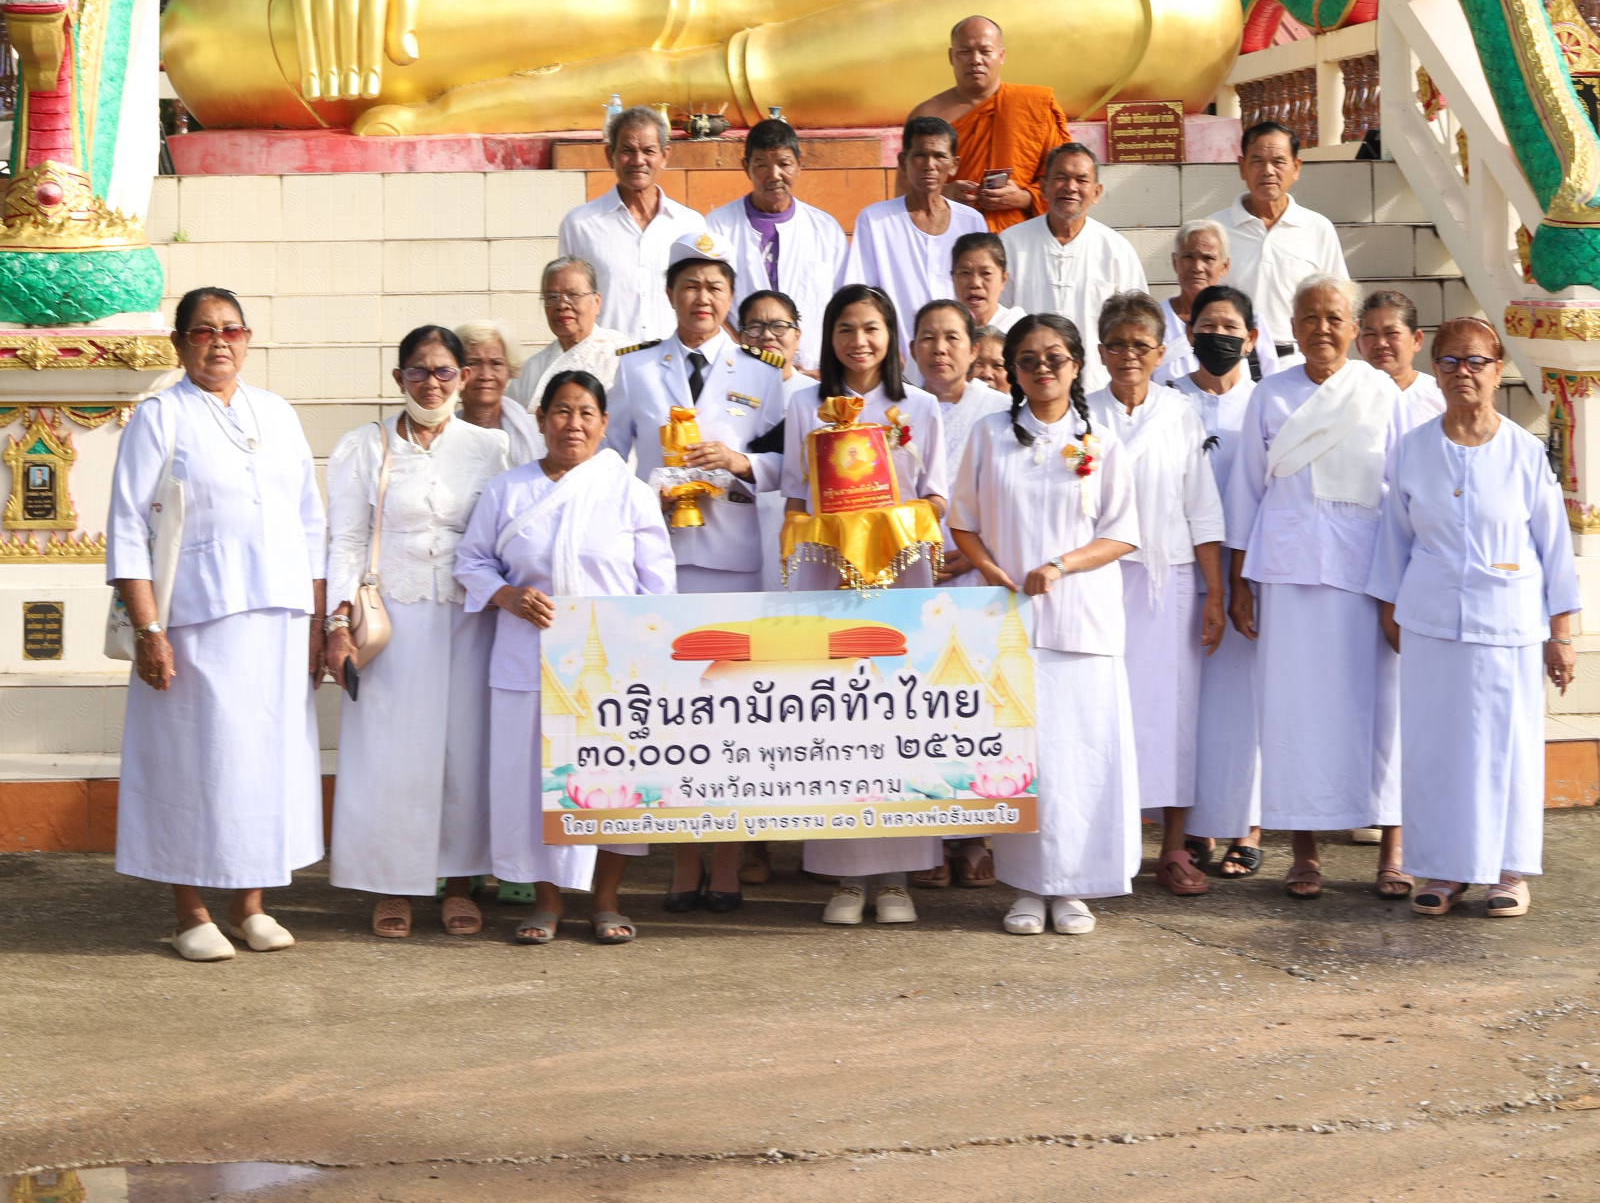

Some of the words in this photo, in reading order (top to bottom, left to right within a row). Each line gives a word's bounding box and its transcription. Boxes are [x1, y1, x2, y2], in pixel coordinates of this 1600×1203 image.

[598, 665, 979, 739] กฐินสามัคคีทั่วไทย
[577, 744, 710, 771] ๓๐,๐๐๐
[721, 740, 750, 764] วัด
[758, 737, 884, 771] พุทธศักราช
[895, 732, 1003, 758] ๒๕๖๘
[679, 775, 902, 799] จังหวัดมหาสารคาม
[563, 816, 596, 834] โดย
[601, 813, 738, 837] คณะศิษยานุศิษย์
[743, 814, 825, 835] บูชาธรรม
[863, 810, 876, 827] ปี
[881, 806, 1019, 828] หลวงพ่อธัมมชโย
